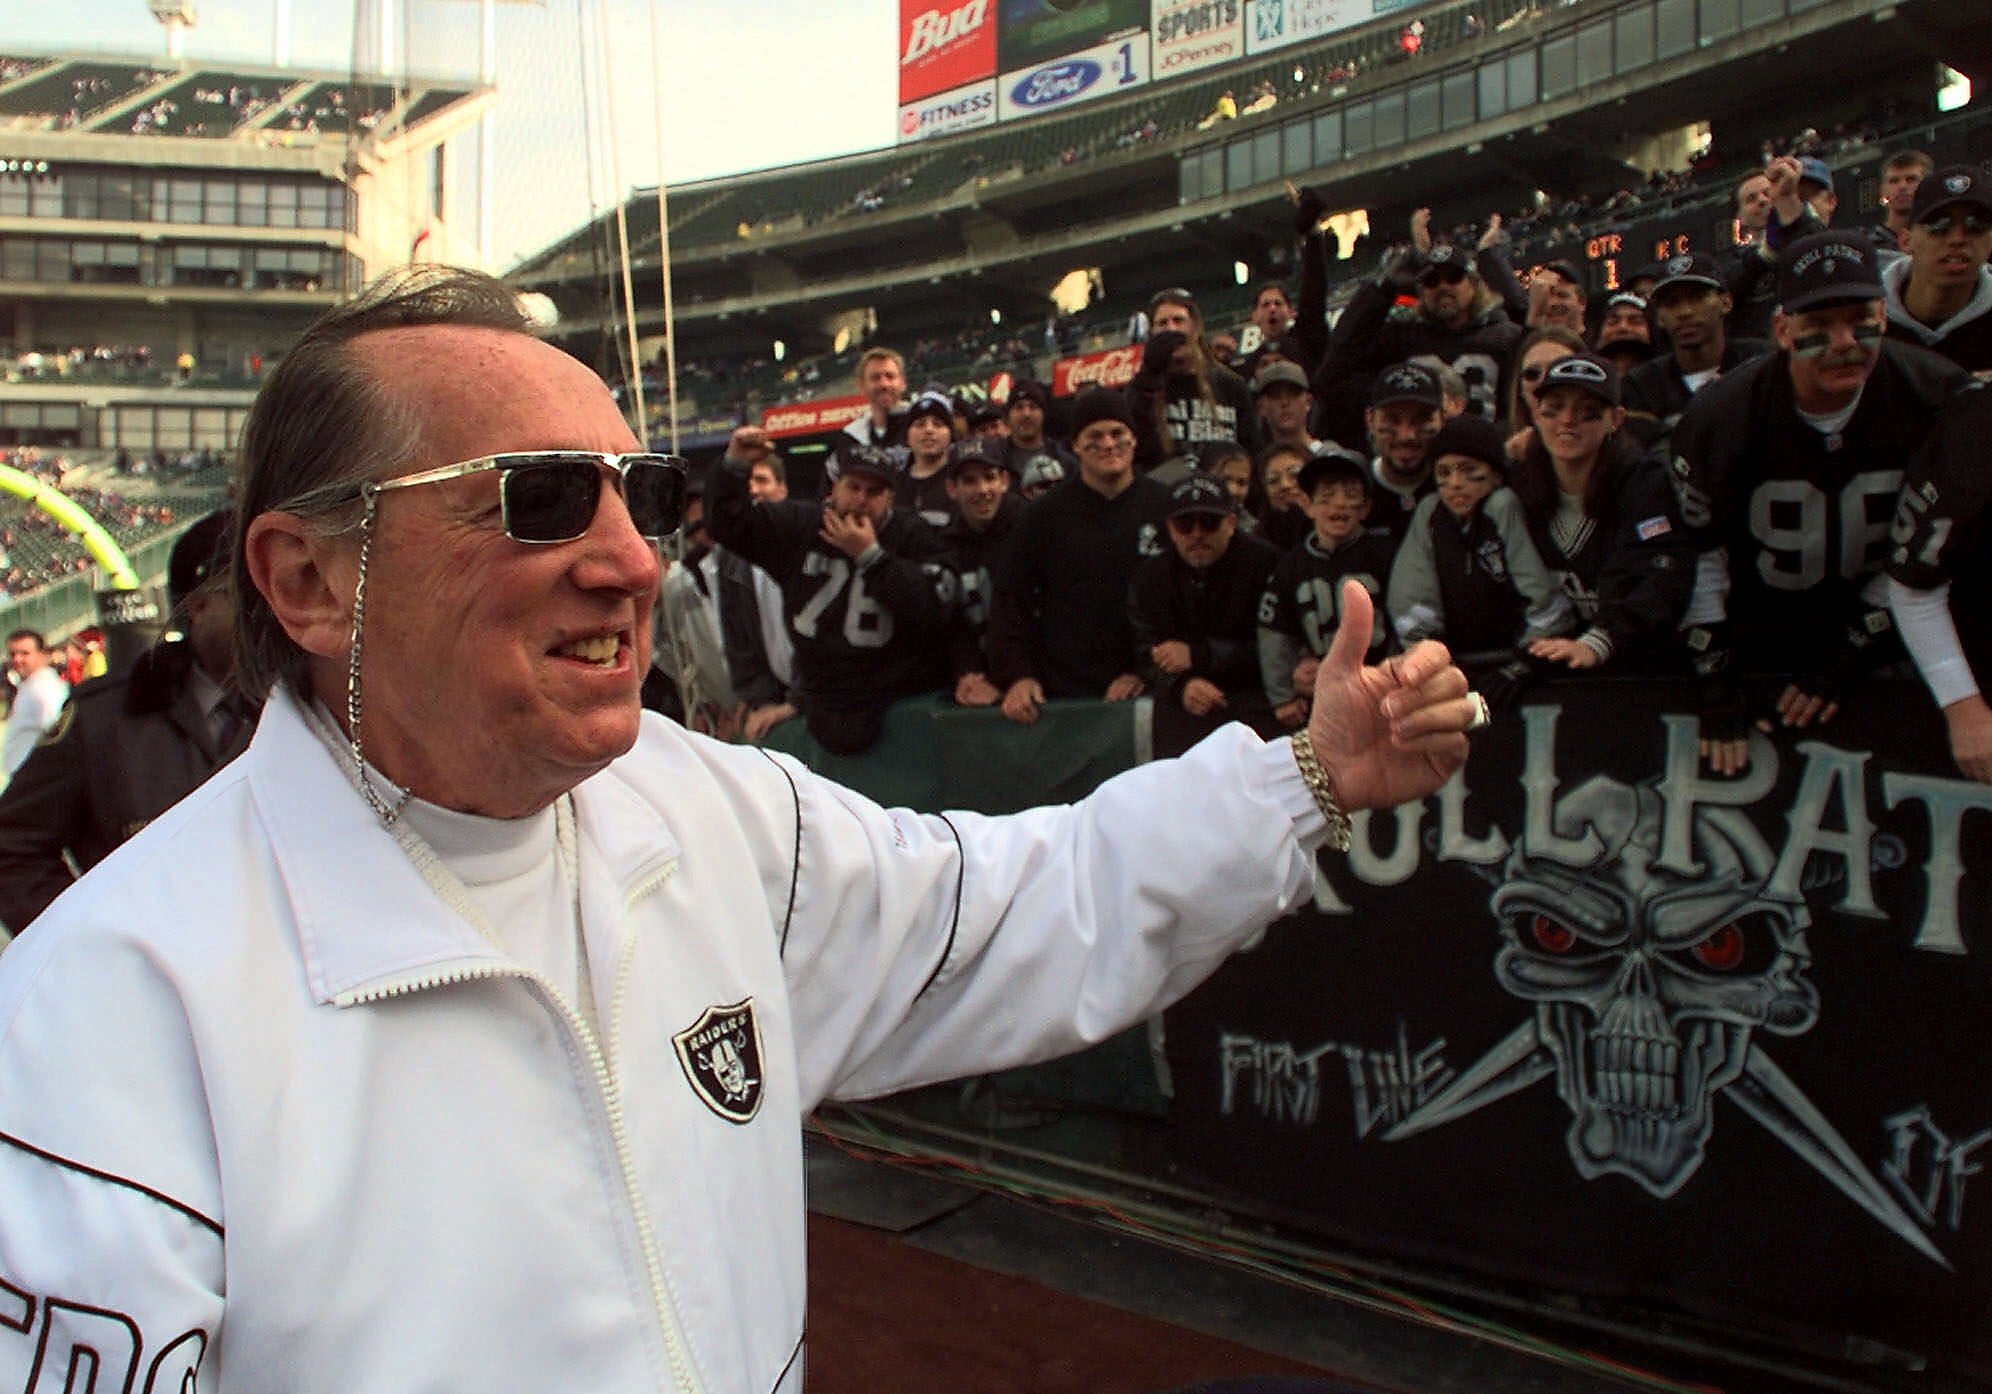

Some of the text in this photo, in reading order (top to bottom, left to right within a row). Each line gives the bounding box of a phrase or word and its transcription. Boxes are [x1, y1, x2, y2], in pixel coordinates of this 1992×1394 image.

[902, 0, 988, 66] Bud
[1158, 0, 1237, 43] SPORTS
[1025, 65, 1086, 103] Ford
[921, 91, 992, 125] FITNESS
[1606, 259, 1620, 289] 1
[794, 552, 893, 648] 76
[689, 1013, 746, 1051] RAIDERS
[1220, 1031, 1338, 1126] FIRST
